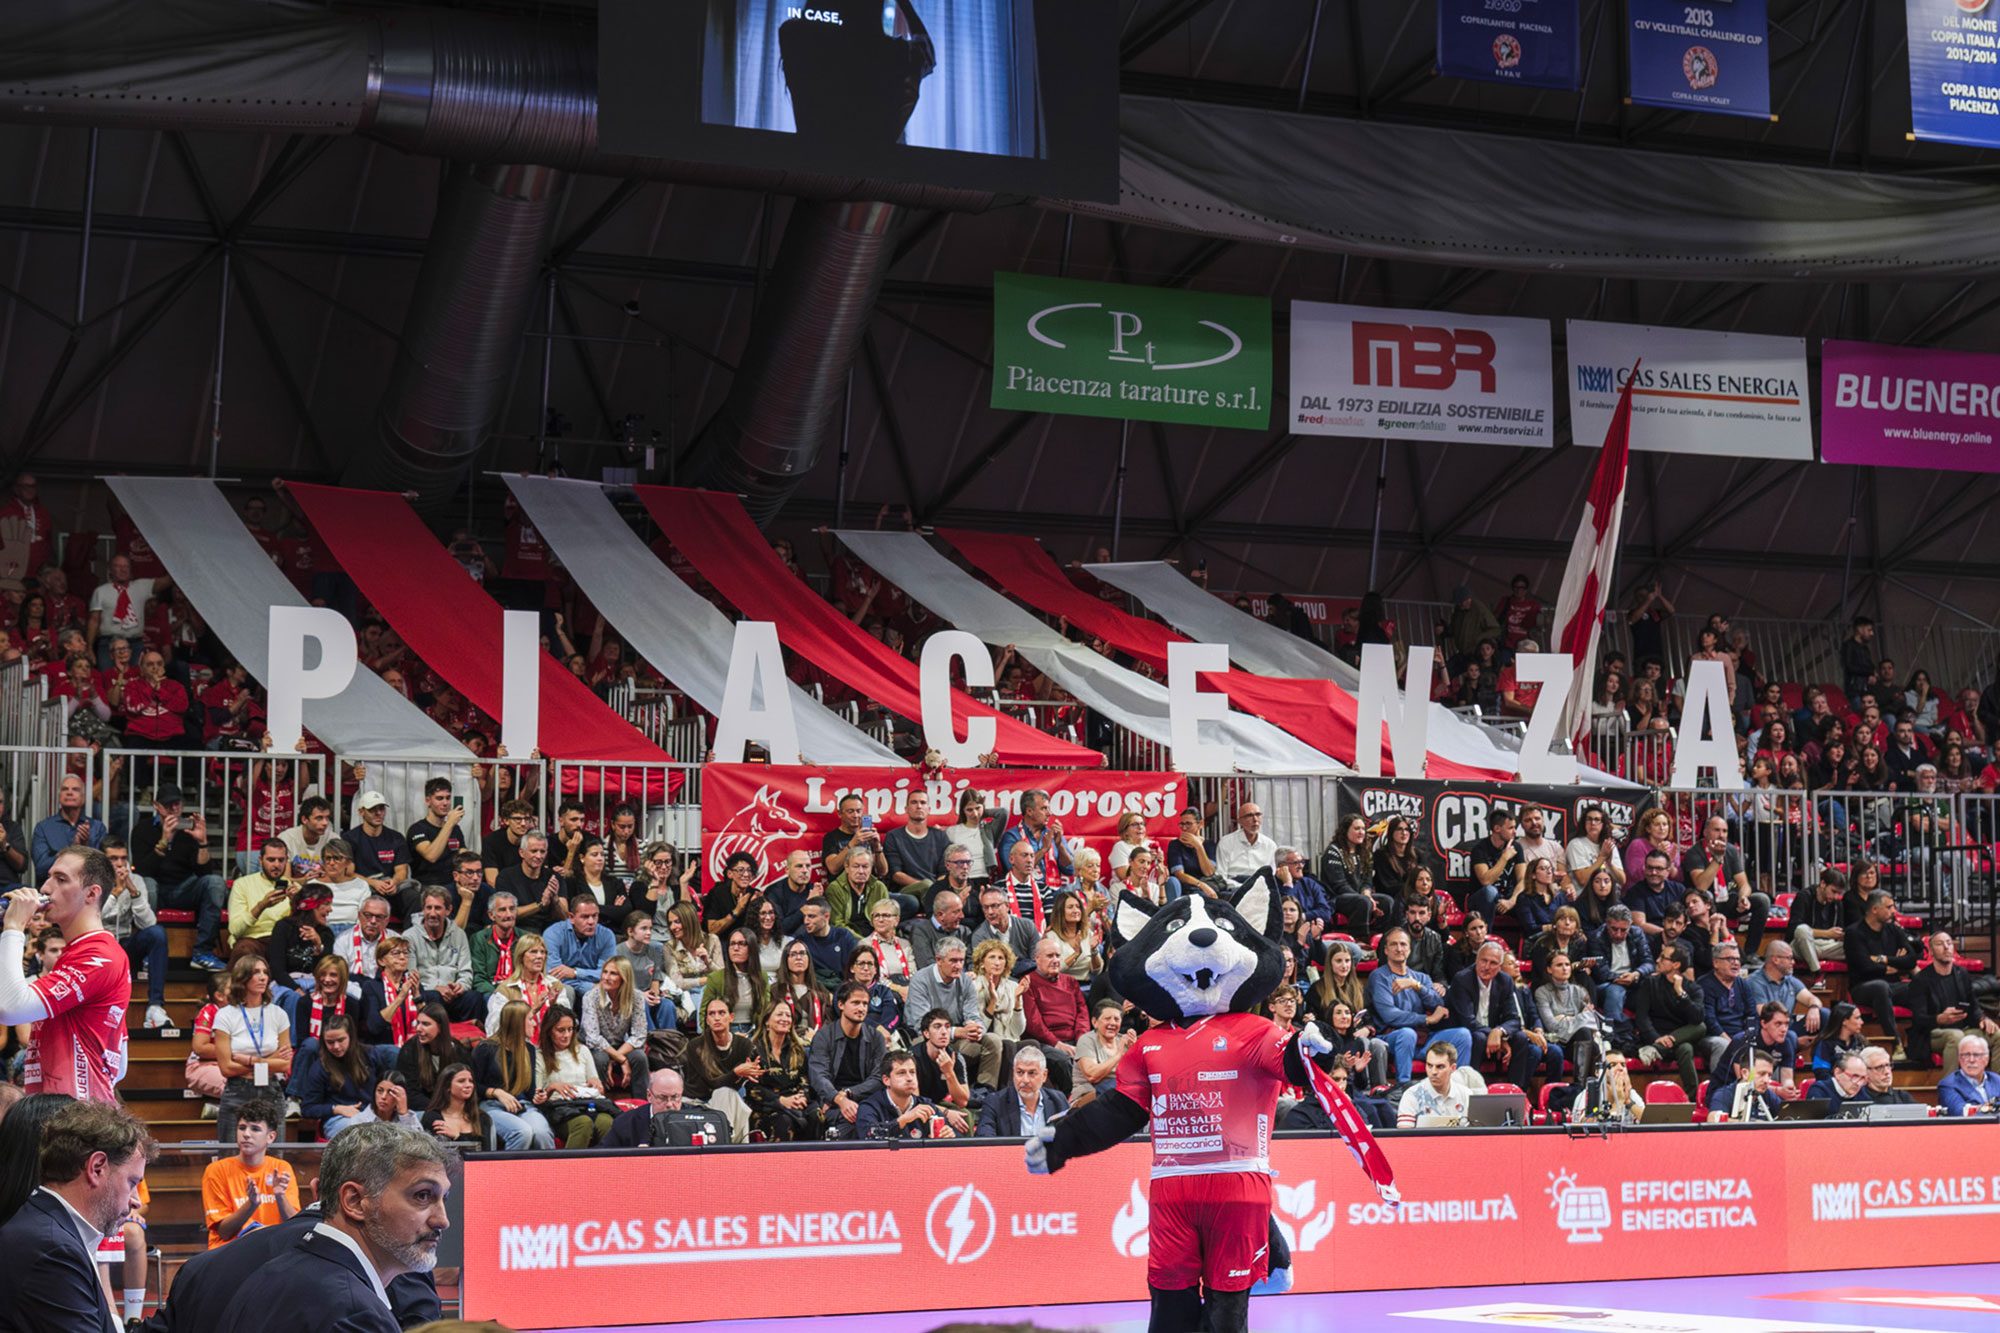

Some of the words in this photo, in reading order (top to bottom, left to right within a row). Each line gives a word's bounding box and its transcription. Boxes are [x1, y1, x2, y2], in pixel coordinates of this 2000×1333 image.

[787, 7, 801, 19] IN
[804, 9, 843, 26] CASE,
[1684, 7, 1714, 27] 2013
[1942, 16, 1960, 28] DEL
[1961, 18, 1998, 33] MONTE
[1519, 22, 1553, 34] PIACENZA
[1634, 20, 1651, 30] CEV
[1652, 22, 1700, 37] VOLLEYBALL
[1700, 28, 1746, 43] CHALLENGE
[1746, 35, 1763, 45] CUP
[1931, 30, 1965, 45] COPPA
[1966, 33, 1996, 48] ITALIA
[1945, 47, 1997, 64] 2013/2014
[1941, 82, 1977, 98] COPRA
[1977, 86, 2000, 100] ELIO
[1949, 98, 1999, 115] PIACENZA
[1351, 320, 1497, 394] MBR
[1006, 365, 1112, 398] Piacenza
[1120, 380, 1210, 406] tarature
[1215, 387, 1262, 411] s.r.l.
[1660, 370, 1712, 392] SALES
[1718, 376, 1799, 397] ENERGIA
[1300, 395, 1332, 411] DAL
[1336, 397, 1373, 413] 1973
[1377, 400, 1442, 417] EDILIZIA
[1446, 403, 1545, 423] SOSTENIBILE
[1457, 423, 1544, 437] www.mbrservizi.it
[1883, 427, 1993, 445] www.bluenergy.online
[1362, 790, 1422, 818] CRAZY
[1169, 1092, 1205, 1102] BANCA
[1209, 1091, 1222, 1100] DI
[1169, 1100, 1224, 1111] PIACENZA
[1168, 1116, 1188, 1126] GAS
[1190, 1114, 1222, 1125] SALES
[1169, 1124, 1223, 1135] ENERGIA
[1621, 1178, 1753, 1203] EFFICIENZA
[1864, 1180, 1913, 1206] GAS
[1919, 1177, 1987, 1204] SALES
[1348, 1194, 1518, 1226] SOSTENIBILITÀ
[1621, 1205, 1758, 1231] ENERGETICA
[574, 1220, 644, 1252] GAS
[653, 1216, 748, 1249] SALES
[758, 1210, 900, 1245] ENERGIA
[1010, 1212, 1078, 1237] LUCE
